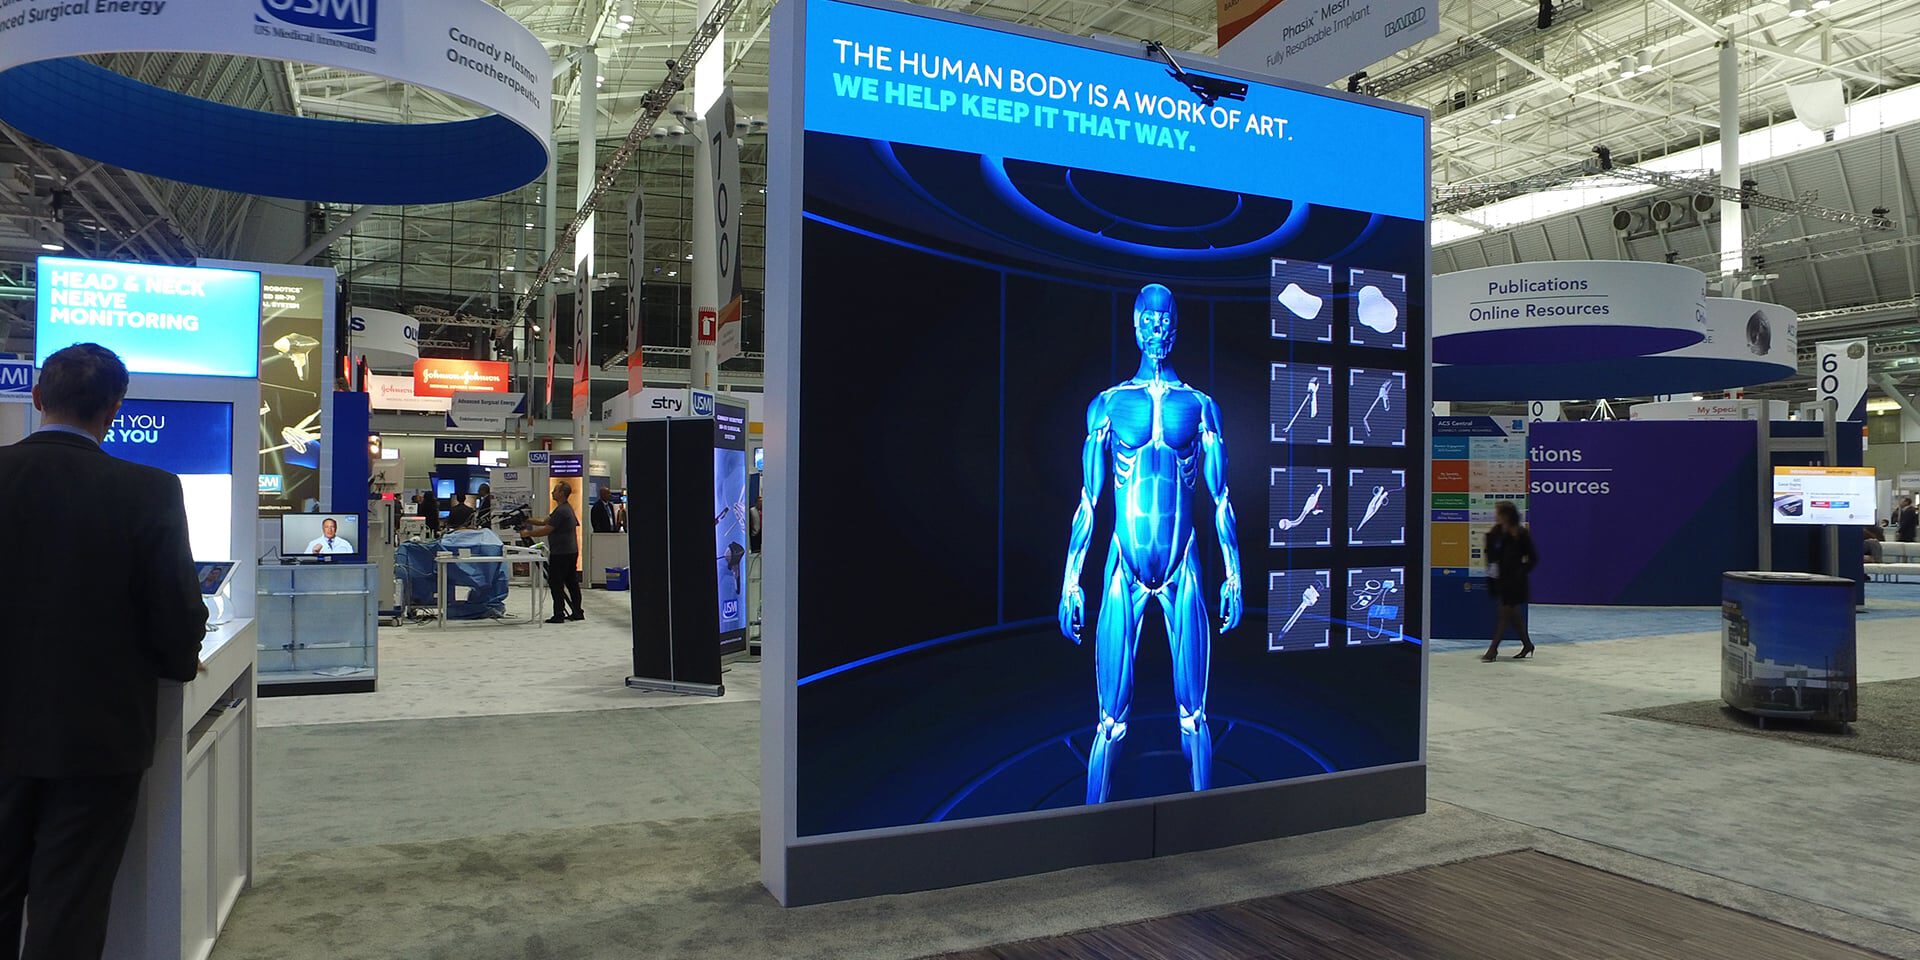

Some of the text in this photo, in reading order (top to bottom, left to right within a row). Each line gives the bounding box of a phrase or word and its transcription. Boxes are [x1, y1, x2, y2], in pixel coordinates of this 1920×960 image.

[28, 0, 89, 23] Surgical
[95, 0, 166, 15] Energy
[1384, 7, 1427, 38] BARD
[273, 27, 315, 42] Medical
[316, 34, 377, 55] Innovations
[449, 27, 501, 61] Canady
[1266, 5, 1370, 67] Fully Resorbable Implant
[446, 48, 540, 110] Oncotherapeutics
[833, 39, 1293, 141] THE HUMAN BODY IS A WORK OF ART.
[833, 72, 1196, 152] WE HELP KEEP IT THAT WAY.
[51, 271, 206, 297] HEAD & NECK
[1488, 277, 1588, 296] Publications
[51, 287, 127, 309] NERVE
[50, 306, 199, 332] MONITORING
[1469, 304, 1610, 322] Online Resources
[694, 394, 712, 412] USMI
[1697, 406, 1710, 415] My
[128, 415, 165, 429] YOU
[119, 429, 159, 443] YOU
[530, 451, 547, 462] USMI
[1529, 445, 1582, 462] tions
[1531, 480, 1610, 494] sources
